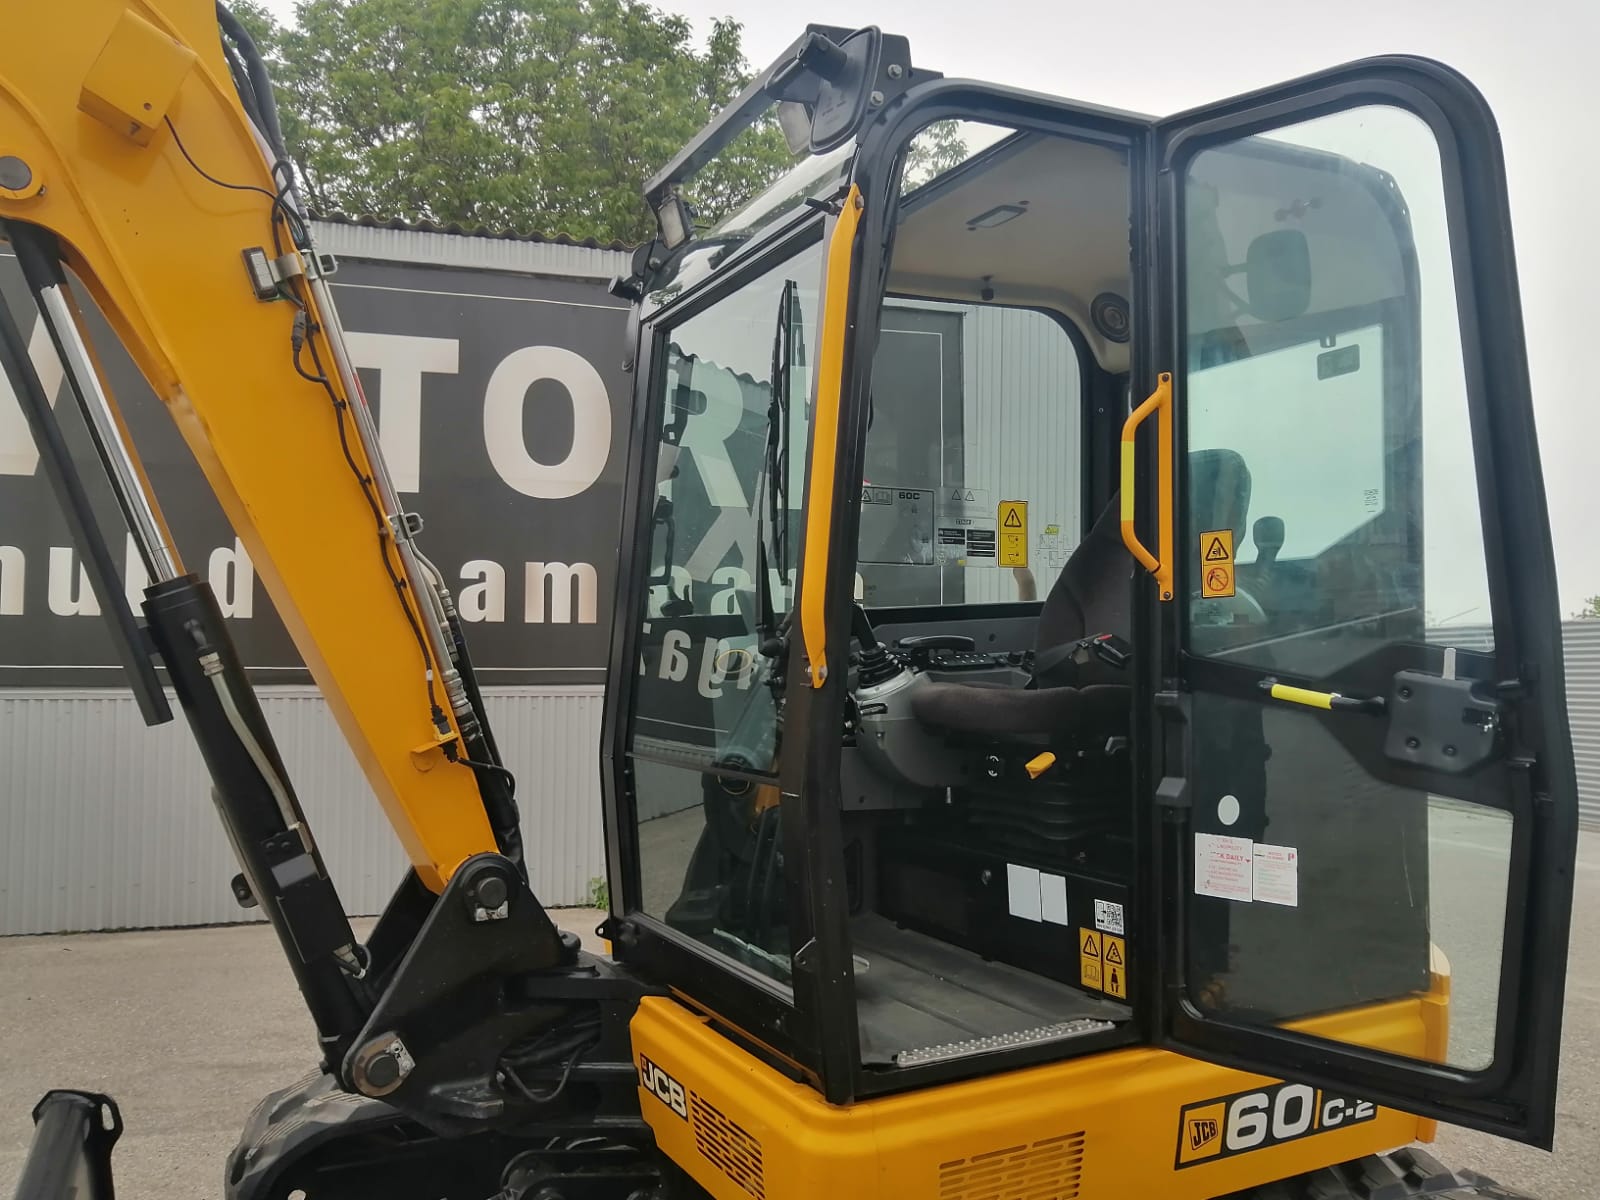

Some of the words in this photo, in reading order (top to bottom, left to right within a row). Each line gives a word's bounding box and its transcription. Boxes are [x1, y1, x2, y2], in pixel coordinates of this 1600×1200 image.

[642, 1061, 688, 1118] JCB
[1192, 1120, 1218, 1148] JCB
[1226, 1083, 1314, 1151] 60
